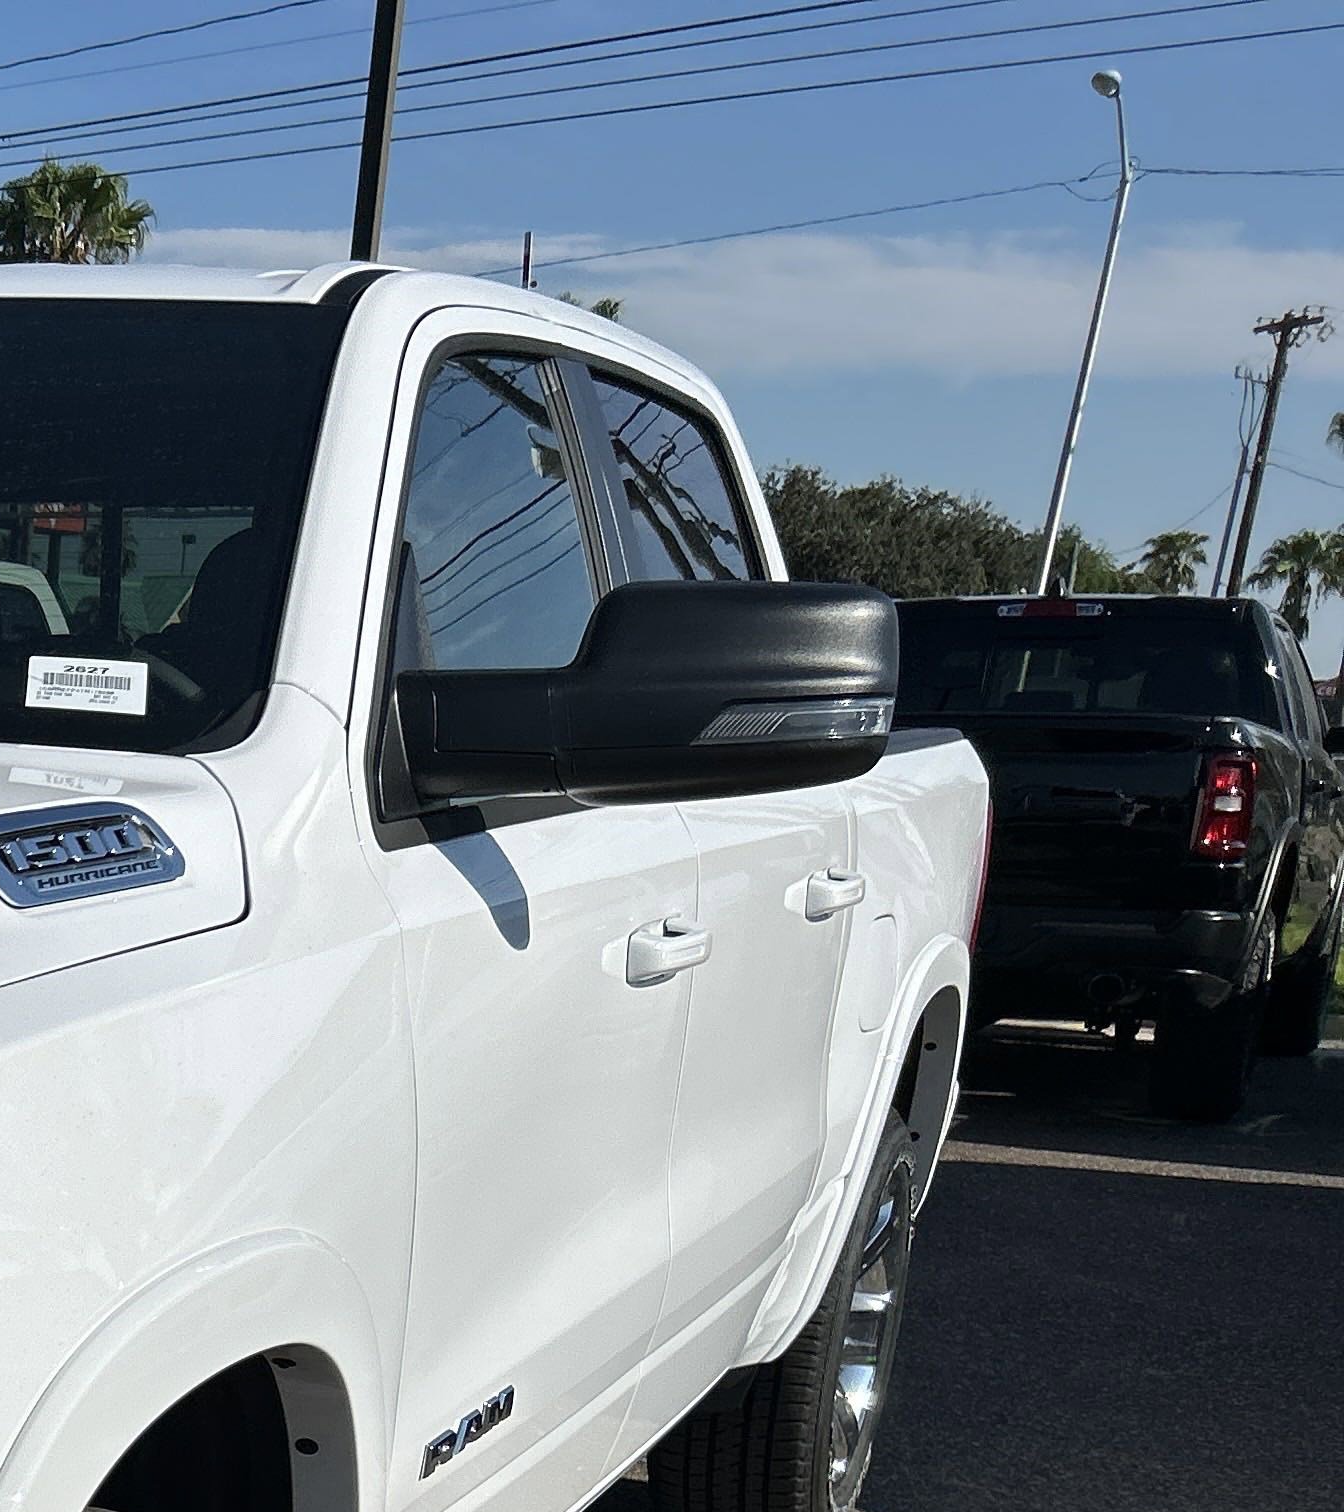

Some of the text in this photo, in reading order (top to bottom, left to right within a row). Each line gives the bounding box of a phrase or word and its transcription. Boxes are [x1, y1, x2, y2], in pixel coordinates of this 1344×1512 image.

[63, 664, 110, 675] 2627
[37, 859, 159, 890] HURRICANE
[418, 1384, 515, 1482] RAM
